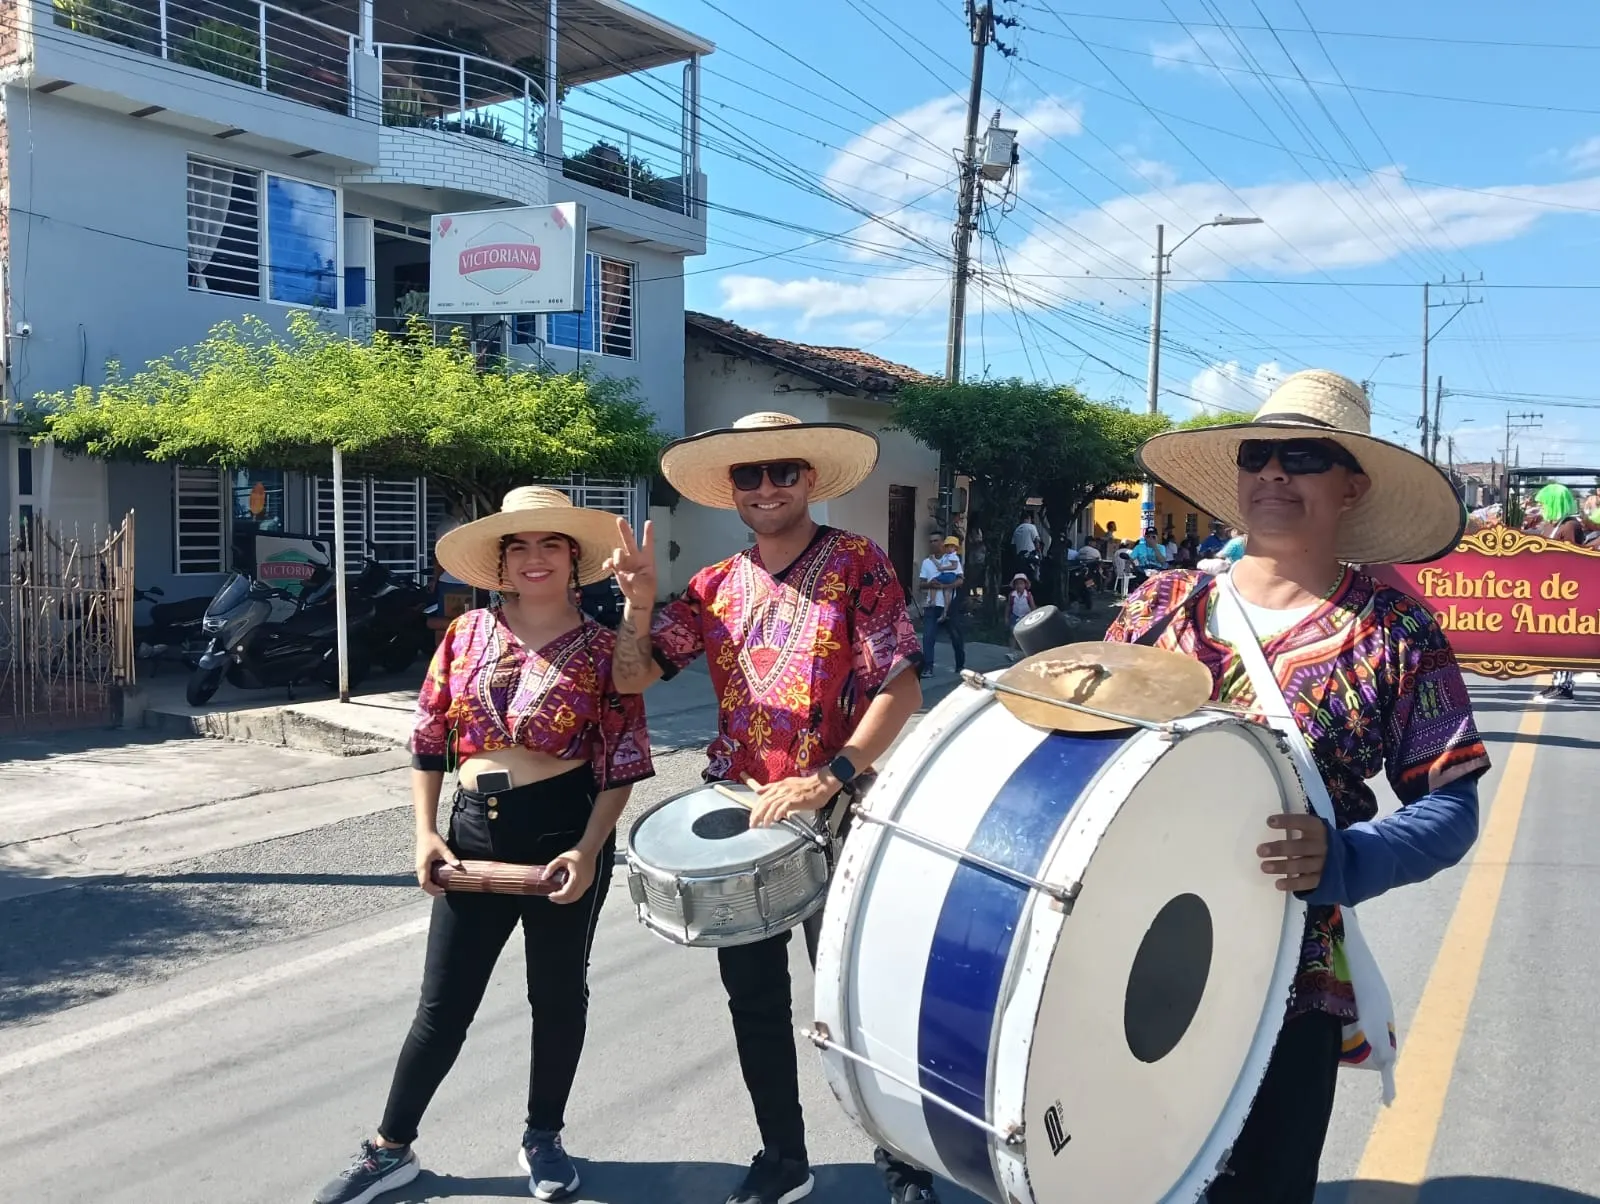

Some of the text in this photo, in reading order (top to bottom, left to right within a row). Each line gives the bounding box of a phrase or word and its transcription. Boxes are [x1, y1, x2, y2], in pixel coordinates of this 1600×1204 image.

[462, 248, 537, 269] VICTORIANA
[1417, 567, 1579, 600] Fábrica de
[1511, 602, 1600, 635] Anda
